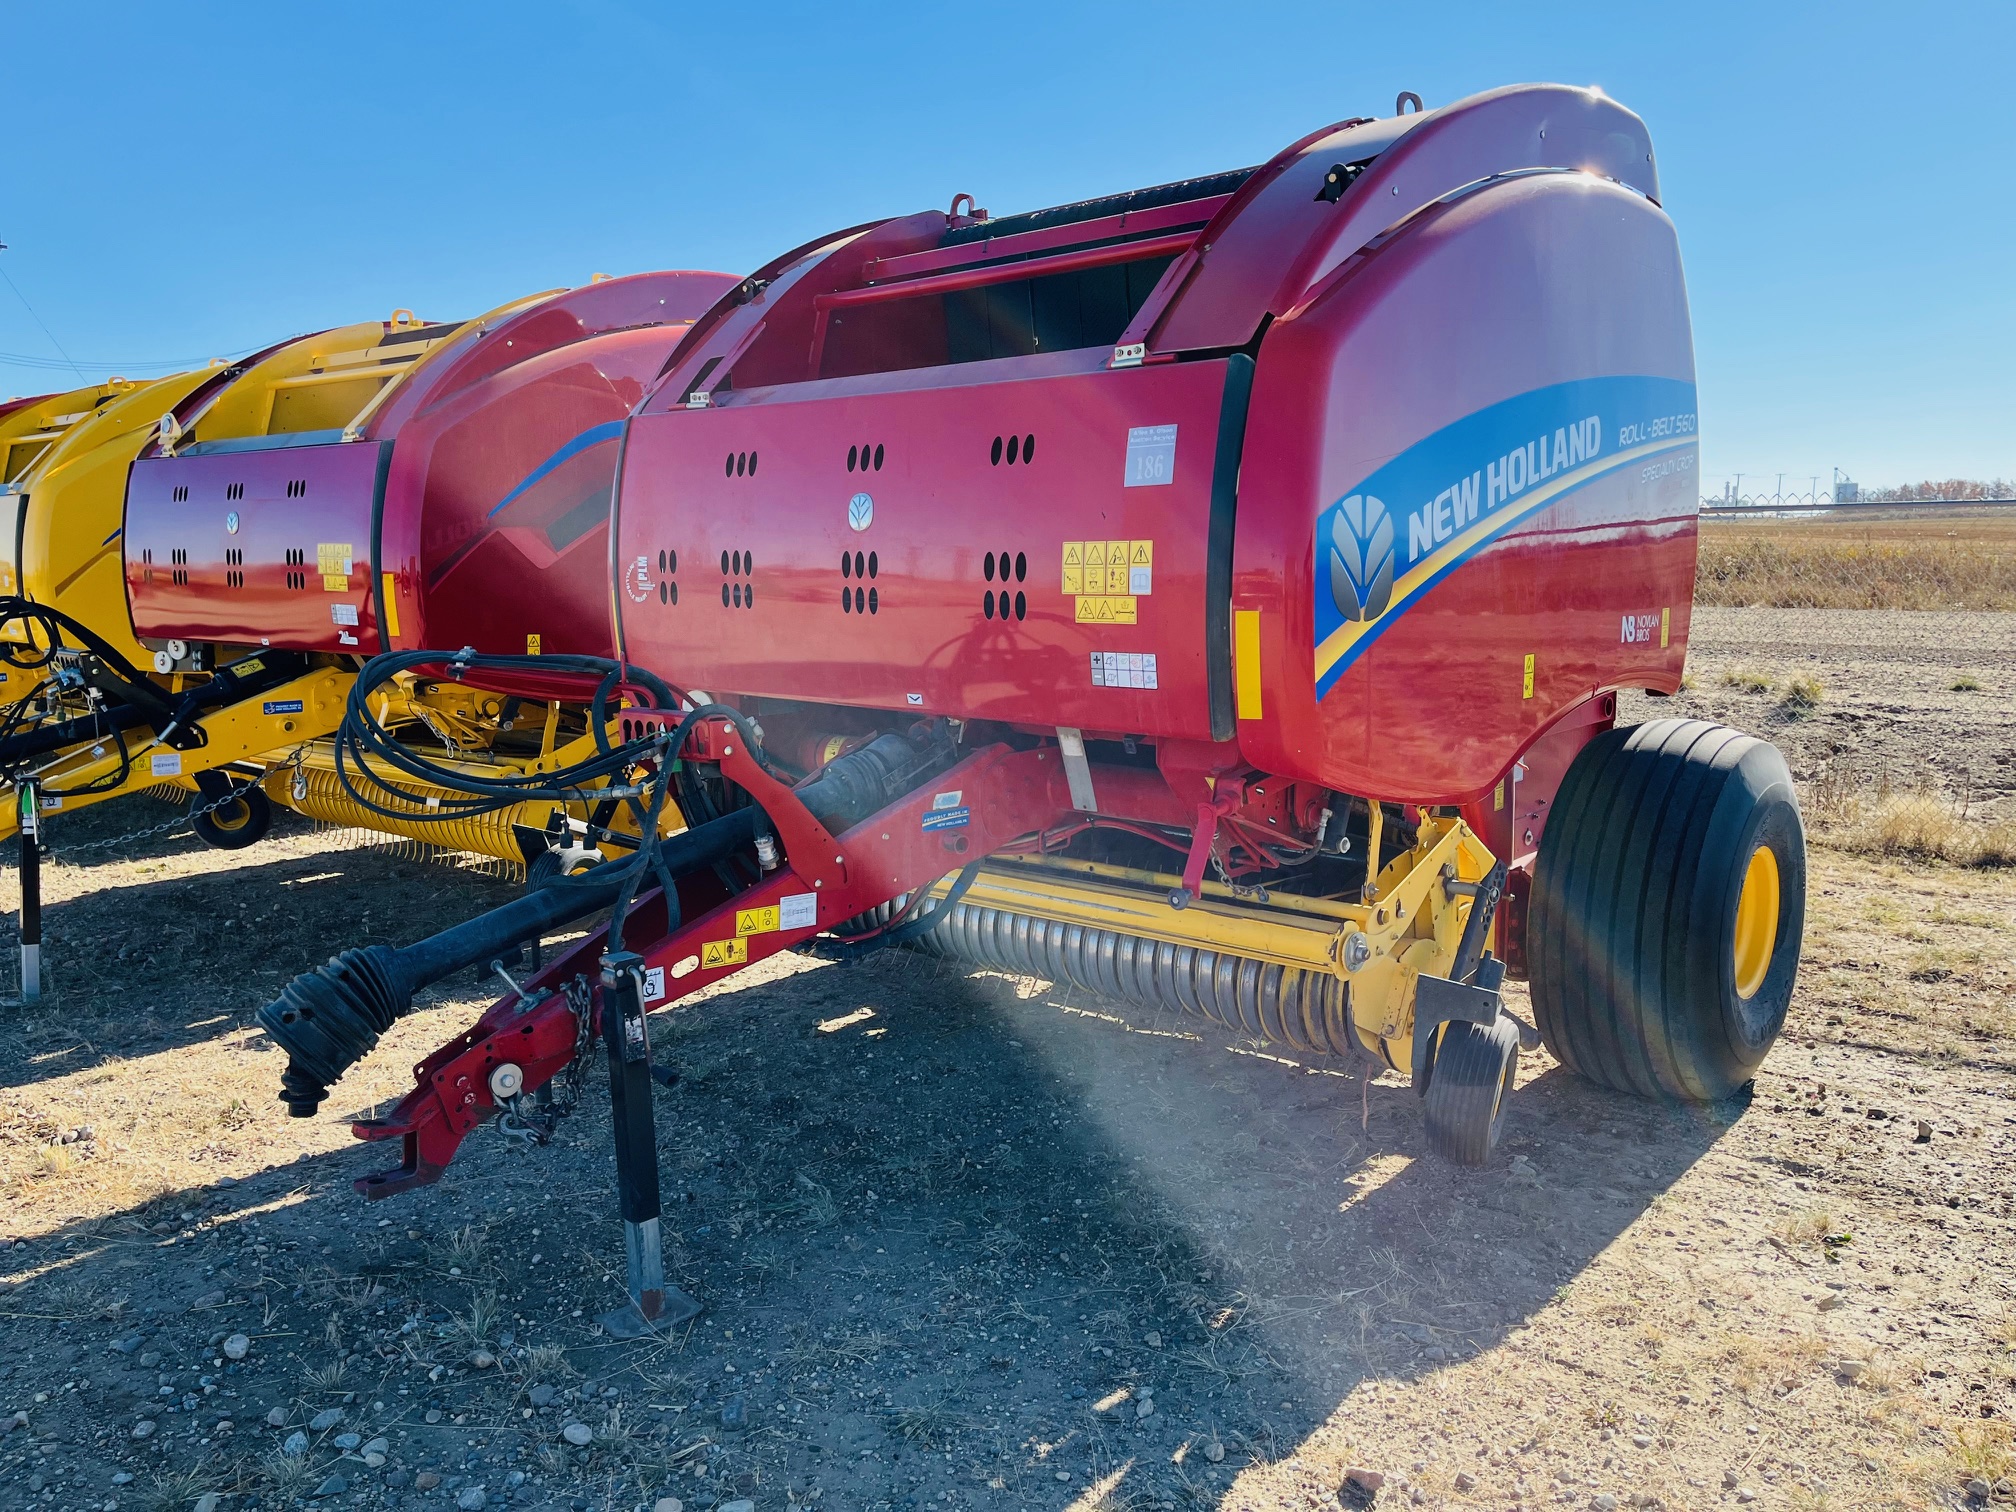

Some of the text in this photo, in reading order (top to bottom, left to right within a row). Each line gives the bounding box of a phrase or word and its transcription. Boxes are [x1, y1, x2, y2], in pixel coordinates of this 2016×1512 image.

[1618, 413, 1696, 447] ROLL-BELT 560
[1136, 454, 1164, 480] 186
[1641, 454, 1694, 484] SPECIALTY CROP
[1408, 415, 1601, 563] NEW HOLLAND
[637, 556, 648, 581] PLM
[1621, 615, 1636, 643] NB
